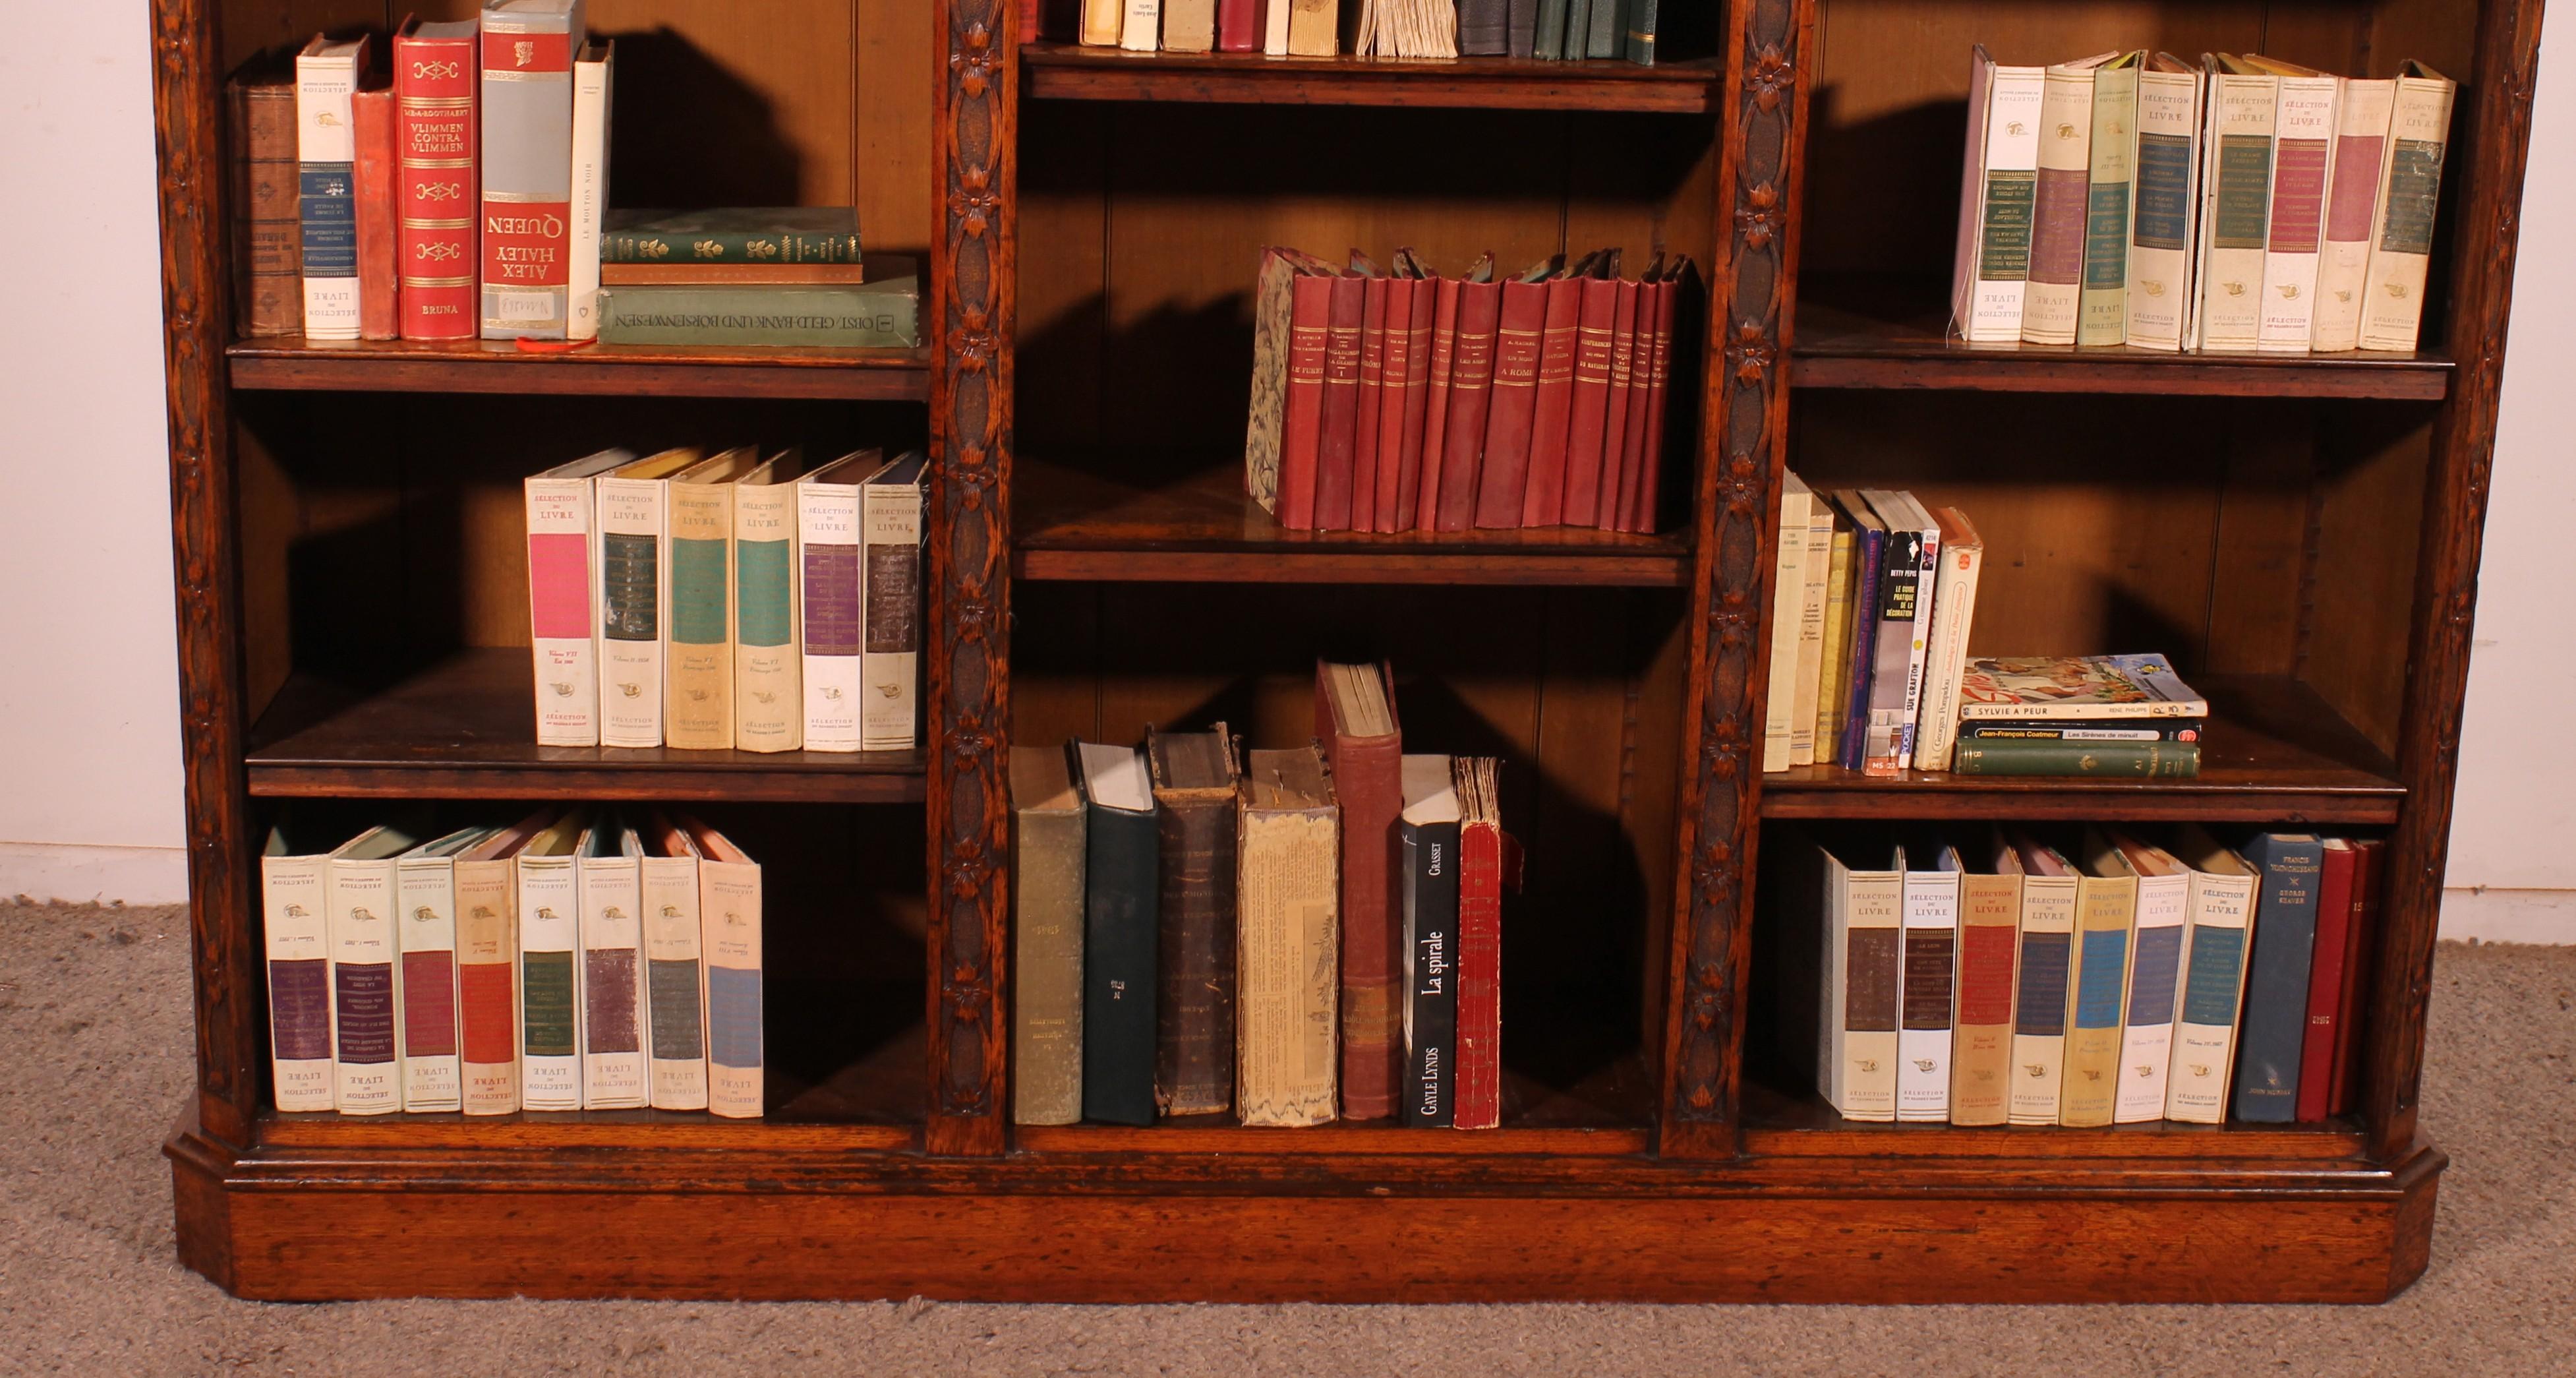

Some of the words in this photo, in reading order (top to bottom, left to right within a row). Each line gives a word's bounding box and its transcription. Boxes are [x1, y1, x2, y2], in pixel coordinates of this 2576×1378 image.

[2150, 111, 2182, 121] LIVRE
[411, 123, 463, 133] VLIMMEN
[415, 133, 460, 142] CONTRA
[411, 142, 463, 153] VLIMMEN
[488, 214, 562, 238] QUEEN
[583, 228, 589, 240] LE
[496, 247, 555, 261] HALEY
[503, 264, 548, 278] ALEX
[313, 292, 349, 301] LIVRE
[2035, 295, 2068, 305] LIVRE
[422, 305, 458, 315] BRUNA
[615, 314, 720, 329] BÖRSENWESEN
[722, 315, 753, 328] UND
[607, 494, 653, 503] SÉLECTION
[613, 512, 647, 520] LIVRE
[683, 517, 717, 525] LIVRE
[747, 519, 780, 527] LIVRE
[815, 523, 848, 531] LIVRE
[1887, 608, 1913, 616] DÉCORATION
[1909, 663, 1919, 695] GRAFTON
[1939, 678, 1951, 714] Pompidou
[1935, 716, 1945, 746] Georges
[1901, 723, 1913, 754] POCKET
[2202, 889, 2245, 898] SÉLECTION
[2150, 906, 2177, 914] LIVRE
[2206, 905, 2239, 914] LIVRE
[1421, 931, 1448, 975] spirale
[1421, 976, 1442, 995] La
[1422, 1047, 1438, 1081] LYNDS
[414, 1067, 448, 1076] LIVRE
[533, 1067, 567, 1077] LIVRE
[597, 1065, 631, 1074] LIVRE
[287, 1072, 321, 1081] LIVRE
[349, 1076, 384, 1085] LIVRE
[660, 1071, 694, 1081] LIVRE
[473, 1077, 507, 1086] LIVRE
[528, 1082, 573, 1091] SÉLECTION
[720, 1079, 751, 1088] LIVRE
[345, 1091, 389, 1100] SÉLECTION
[1420, 1081, 1437, 1116] GAYLE
